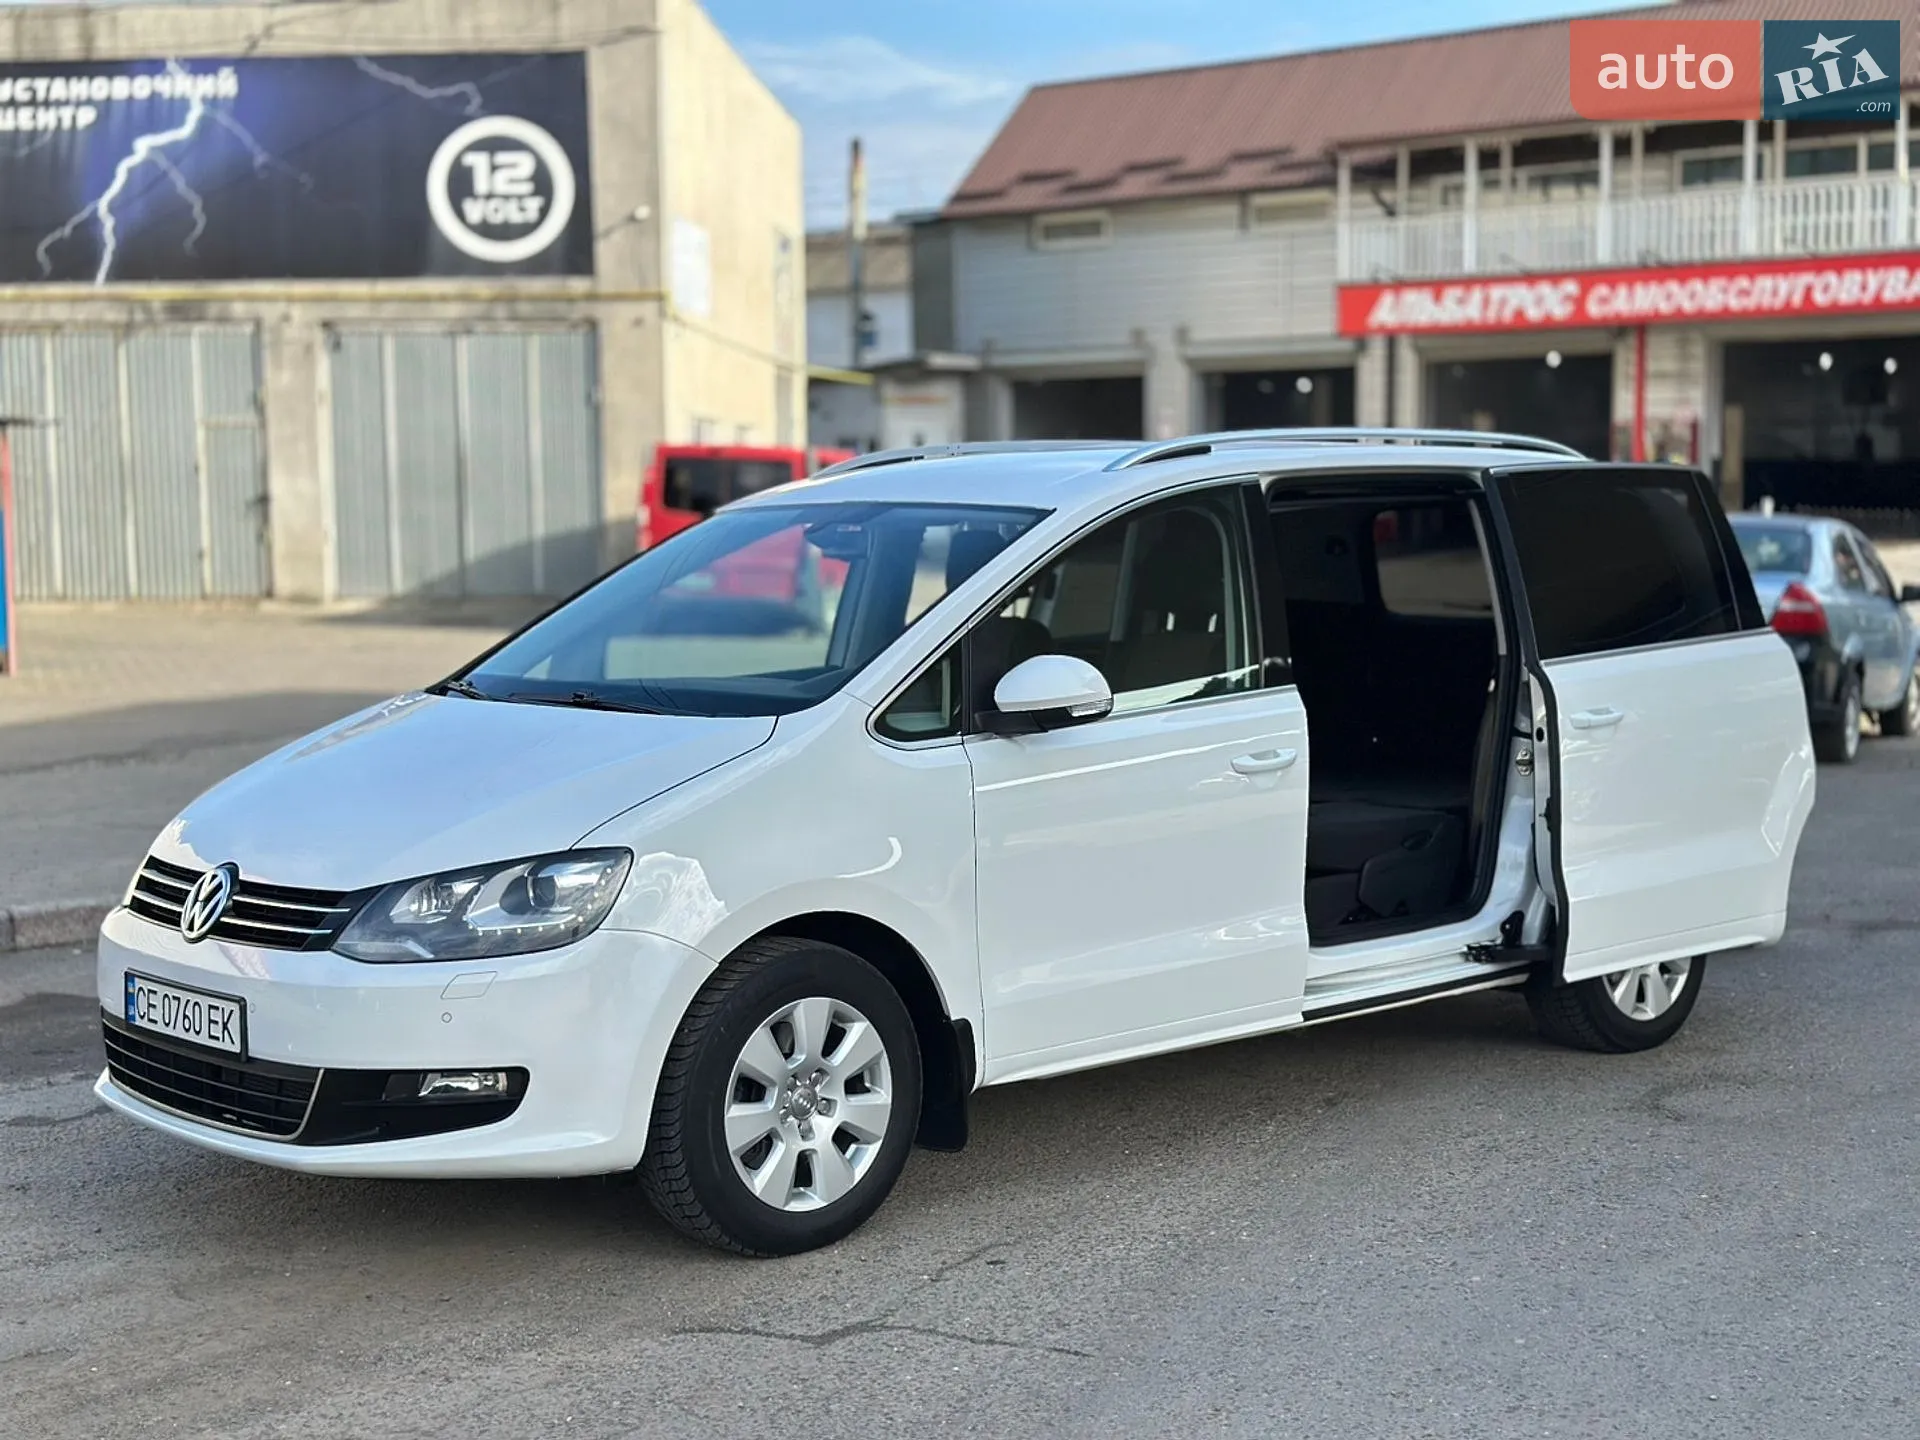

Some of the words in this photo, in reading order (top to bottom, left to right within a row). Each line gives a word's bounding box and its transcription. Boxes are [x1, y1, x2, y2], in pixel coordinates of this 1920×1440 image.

[460, 149, 537, 197] 12
[460, 195, 546, 226] VOLT
[1365, 278, 1581, 330] АЛЬБАТРОС
[136, 985, 159, 1025] CE
[162, 992, 203, 1037] 0760
[207, 1003, 236, 1046] EK
